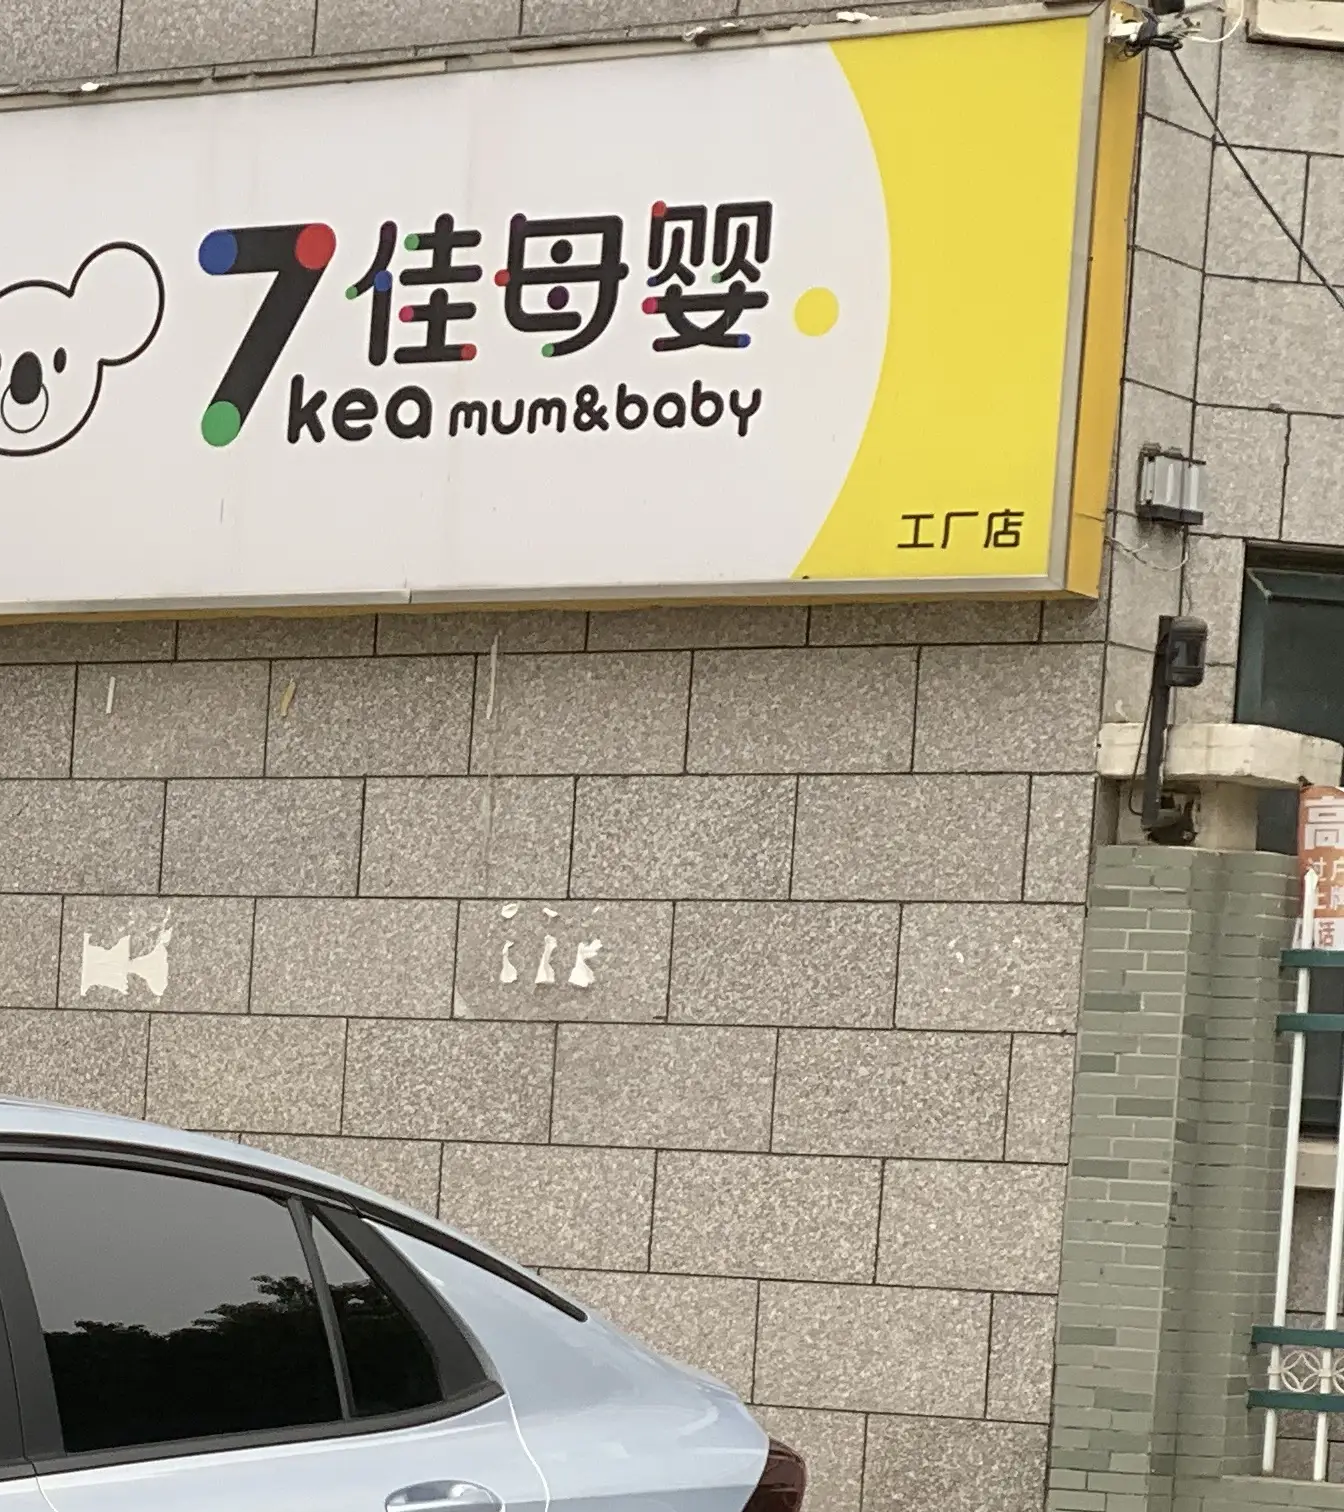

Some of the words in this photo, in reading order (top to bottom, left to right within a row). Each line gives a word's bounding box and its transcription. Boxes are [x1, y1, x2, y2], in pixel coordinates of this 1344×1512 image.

[287, 374, 433, 444] kea
[448, 379, 762, 437] mum&baby
[896, 508, 1024, 550] 工厂店
